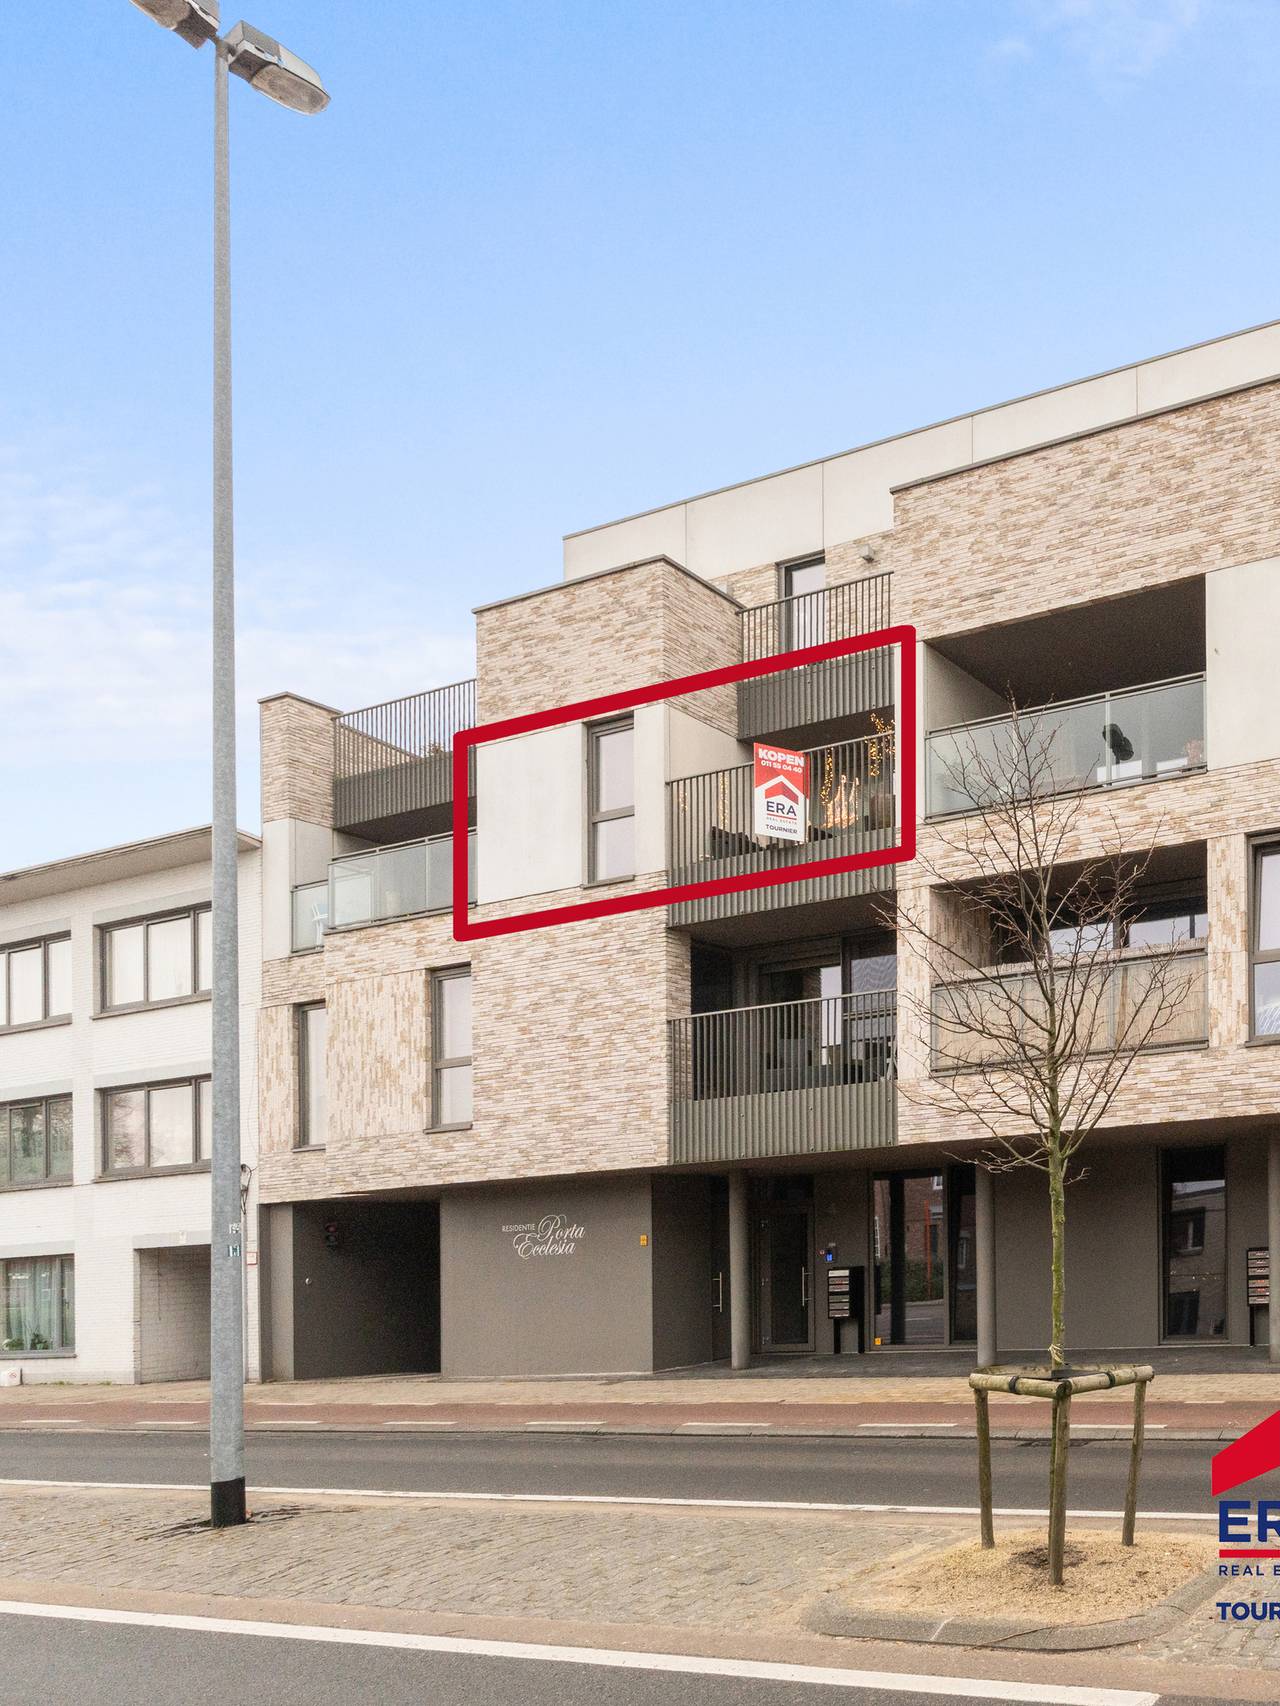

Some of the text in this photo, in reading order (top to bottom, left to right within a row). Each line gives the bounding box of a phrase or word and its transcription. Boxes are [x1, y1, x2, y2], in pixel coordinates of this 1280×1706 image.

[758, 748, 804, 766] KOPEN
[766, 801, 797, 817] ERA
[765, 824, 798, 834] TOURNIER
[501, 1214, 585, 1241] RESIDENTIE Porta
[513, 1232, 576, 1260] Ecclesia
